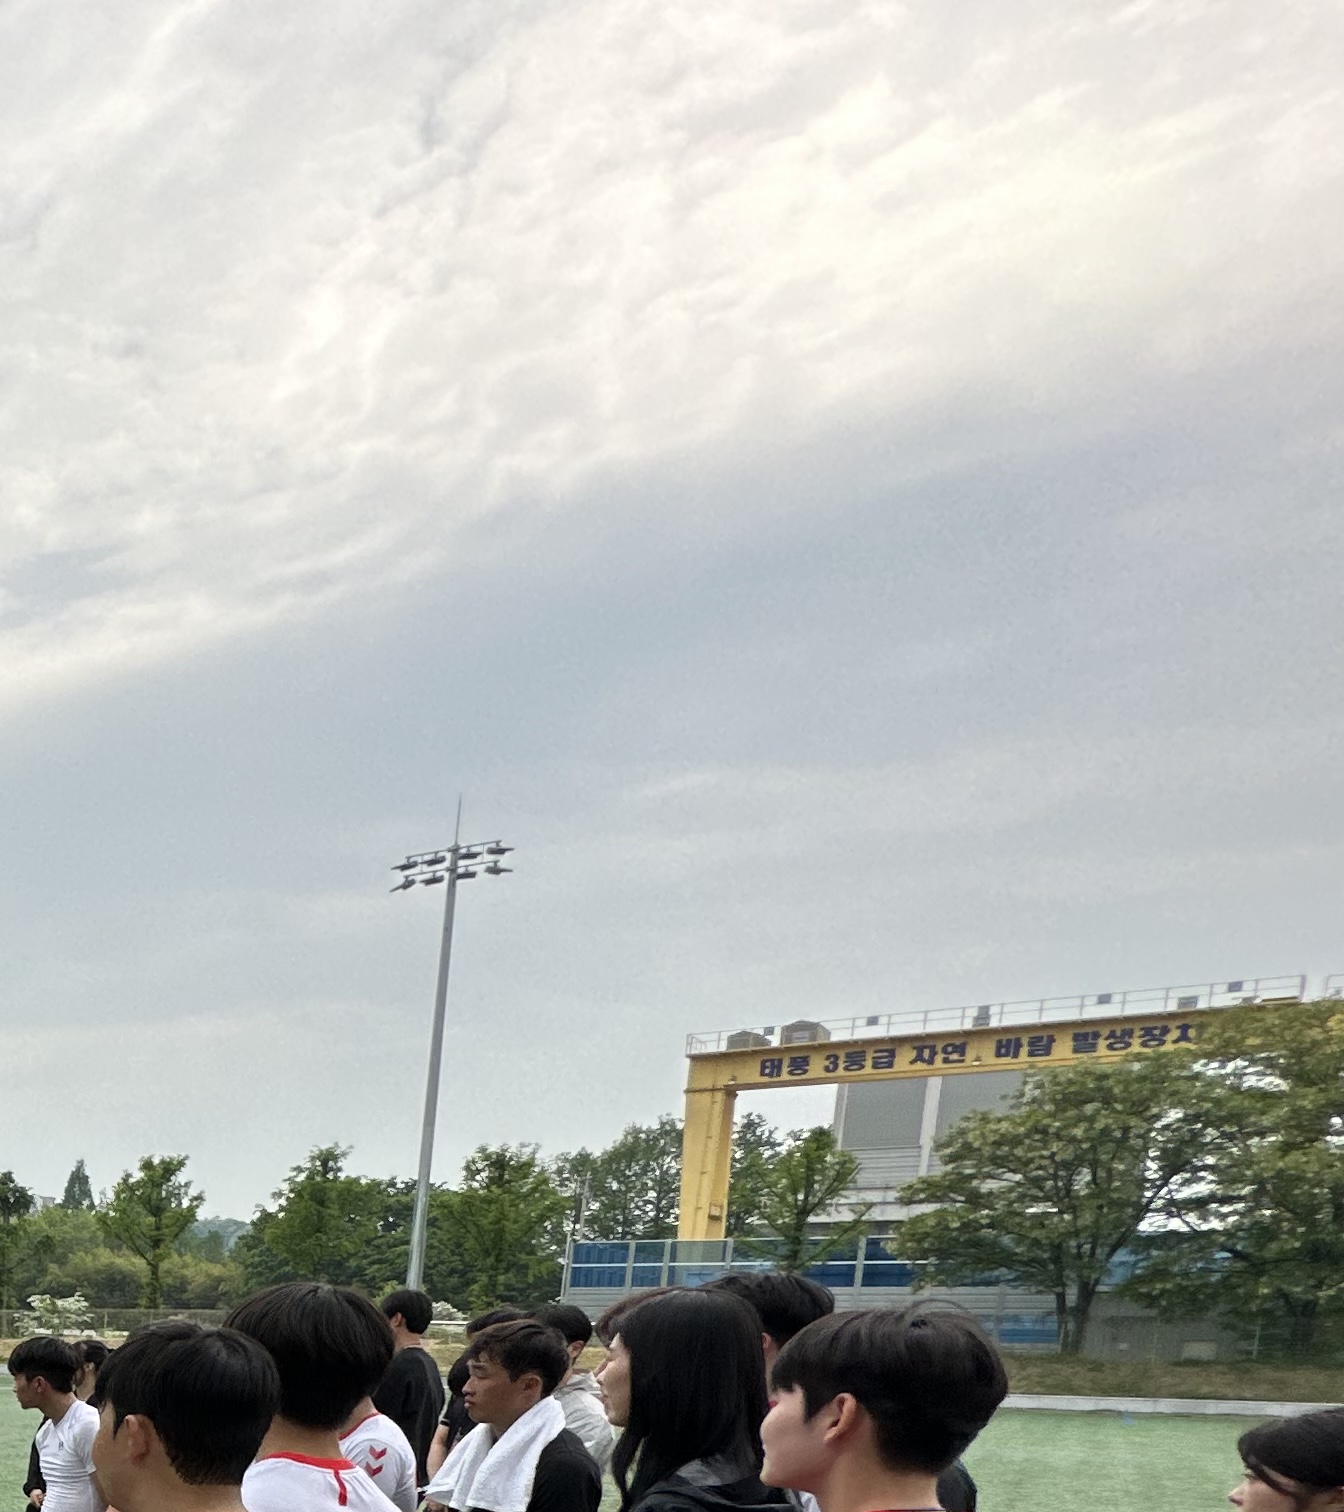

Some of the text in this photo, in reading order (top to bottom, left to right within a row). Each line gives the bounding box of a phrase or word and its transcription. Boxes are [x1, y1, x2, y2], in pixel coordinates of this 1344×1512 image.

[760, 1055, 810, 1078] 태풍
[824, 1047, 896, 1073] 3등급
[909, 1041, 968, 1066] 자연
[995, 1034, 1055, 1059] 바람
